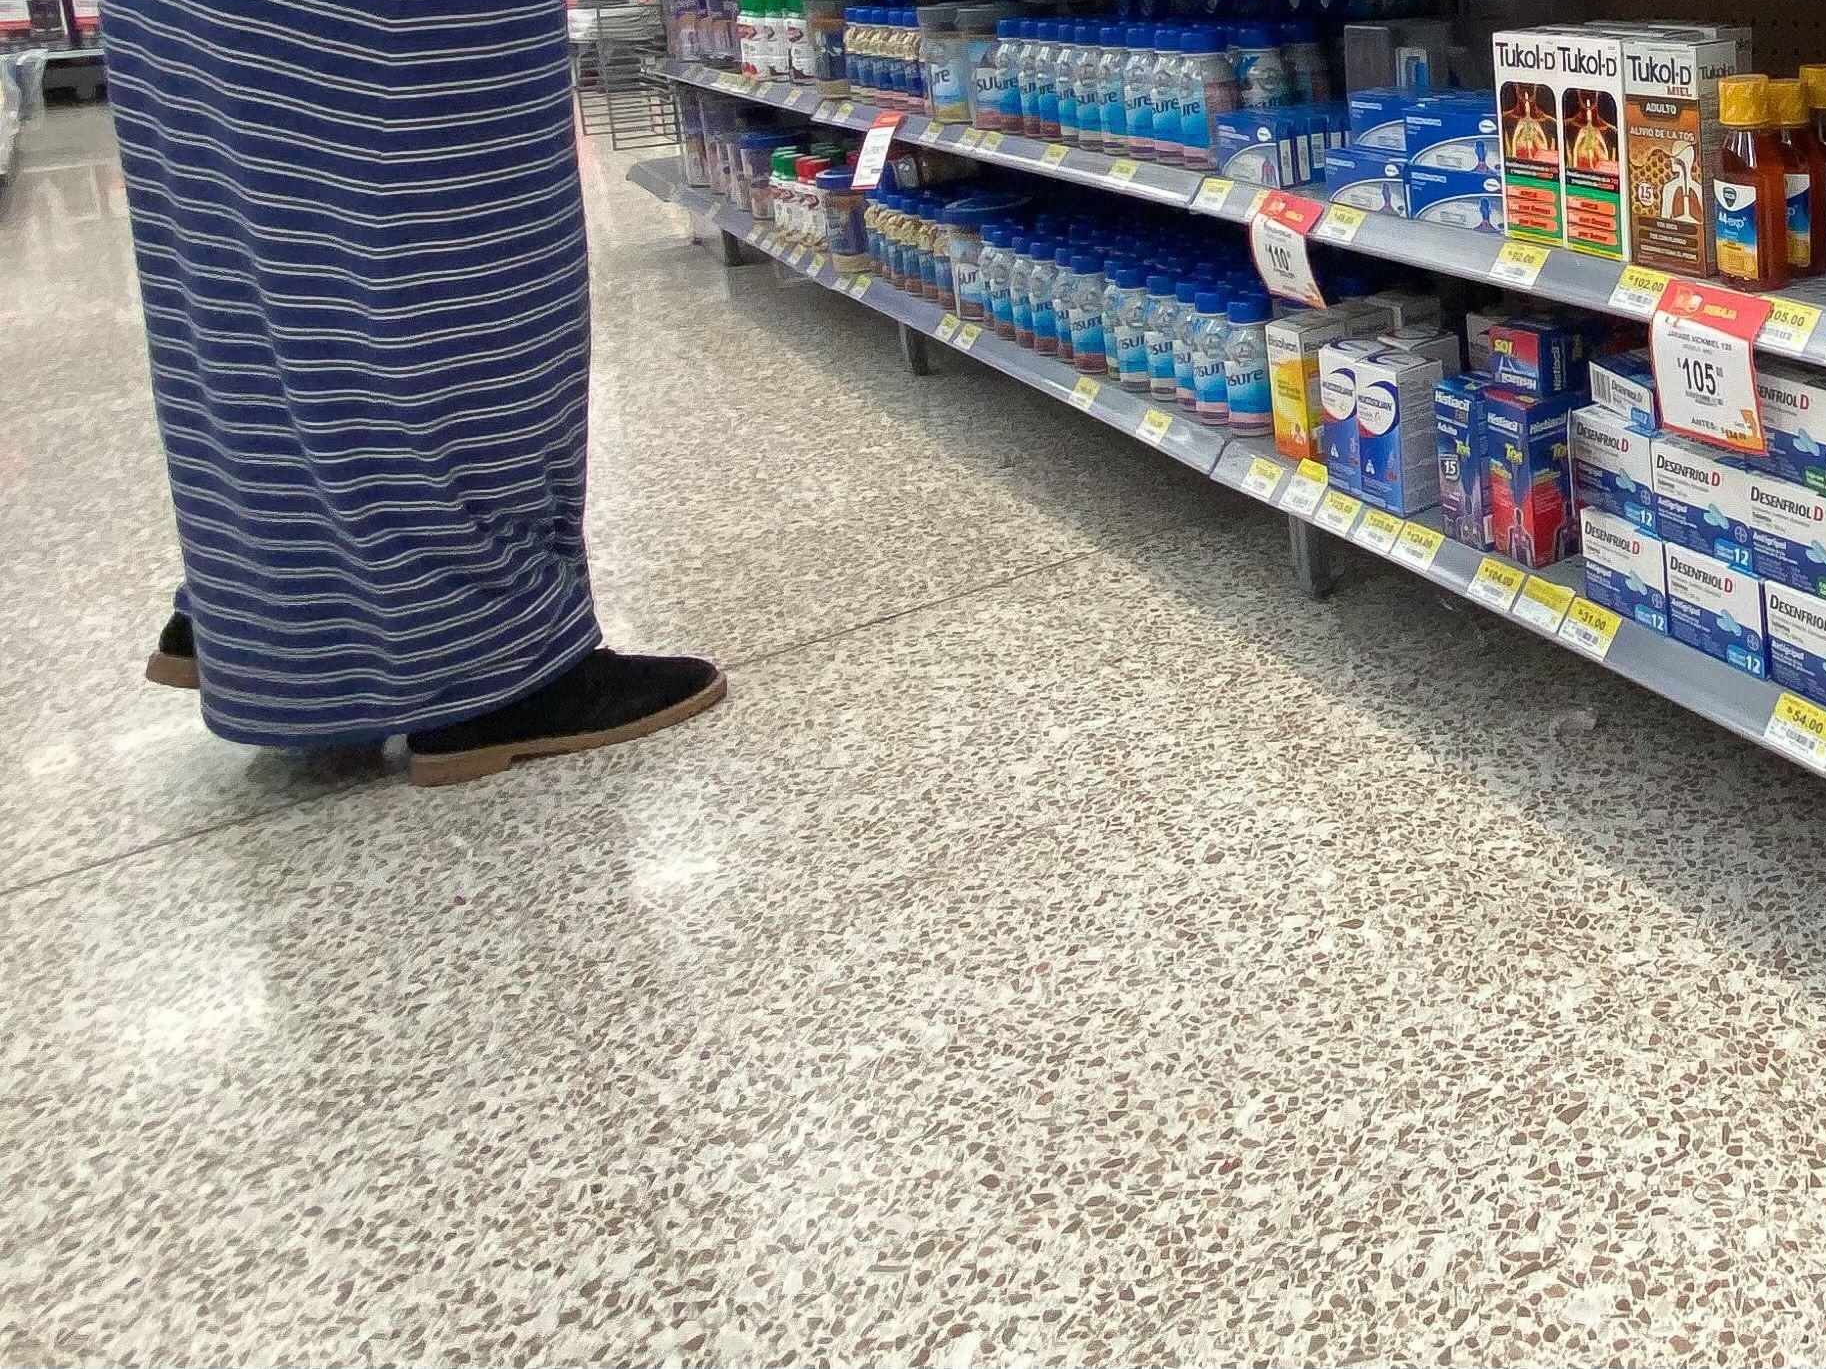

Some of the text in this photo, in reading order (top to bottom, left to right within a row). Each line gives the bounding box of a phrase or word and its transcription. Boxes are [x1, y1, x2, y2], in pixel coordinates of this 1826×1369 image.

[1667, 87, 1692, 97] MIEL
[1645, 102, 1677, 114] ADULTO
[1639, 185, 1651, 198] 15
[1443, 461, 1456, 475] 15
[1751, 486, 1824, 522] DESENFRIOL D
[1733, 549, 1749, 566] 12
[1670, 556, 1734, 594] DESENFRIOL D
[1745, 656, 1762, 673] 12
[1787, 705, 1824, 735] $54.00
